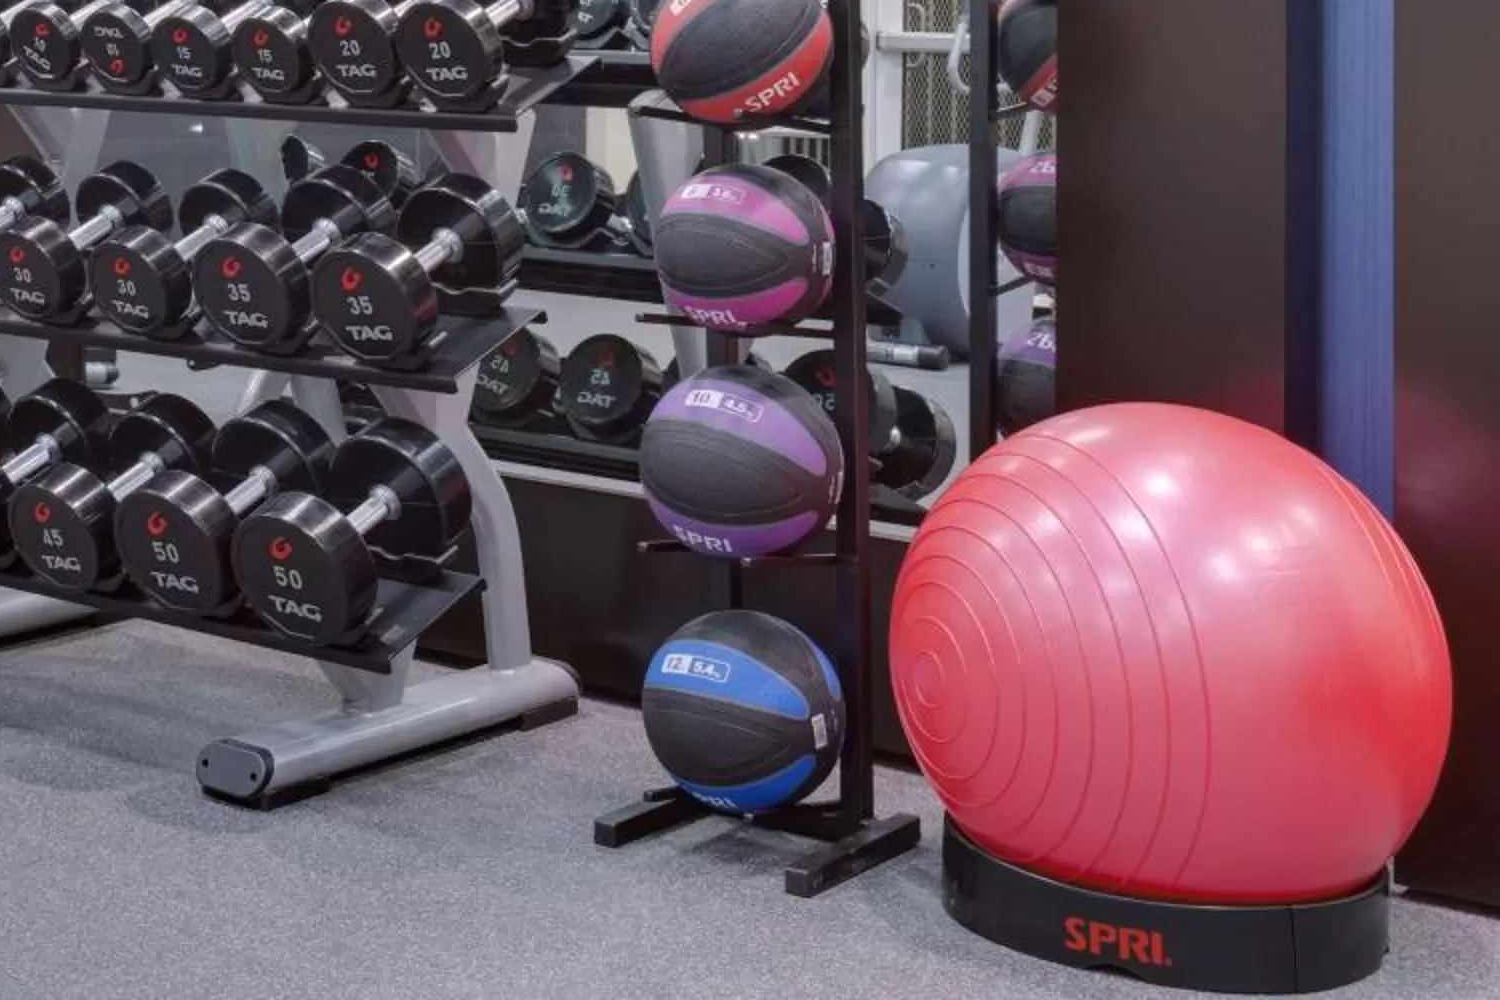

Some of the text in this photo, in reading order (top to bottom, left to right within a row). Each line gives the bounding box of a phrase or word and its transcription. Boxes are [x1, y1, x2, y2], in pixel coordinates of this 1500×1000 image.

[176, 47, 192, 60] 15
[258, 49, 273, 62] 15
[339, 40, 360, 57] 20
[428, 41, 451, 59] 20
[170, 64, 203, 77] TAG
[252, 67, 284, 81] TAG
[335, 64, 377, 77] TAG
[425, 66, 468, 82] TAG
[744, 71, 800, 113] SPRI
[13, 267, 31, 283] 30
[10, 287, 45, 305] TAG
[117, 279, 136, 296] 30
[227, 283, 251, 302] 35
[111, 300, 149, 319] TAG
[346, 296, 373, 315] 35
[224, 310, 268, 329] TAG
[345, 325, 393, 341] TAG
[42, 528, 63, 548] 45
[151, 541, 179, 564] 50
[41, 554, 81, 571] TAG
[151, 571, 199, 594] TAG
[272, 565, 303, 590] 50
[267, 594, 322, 622] TAG
